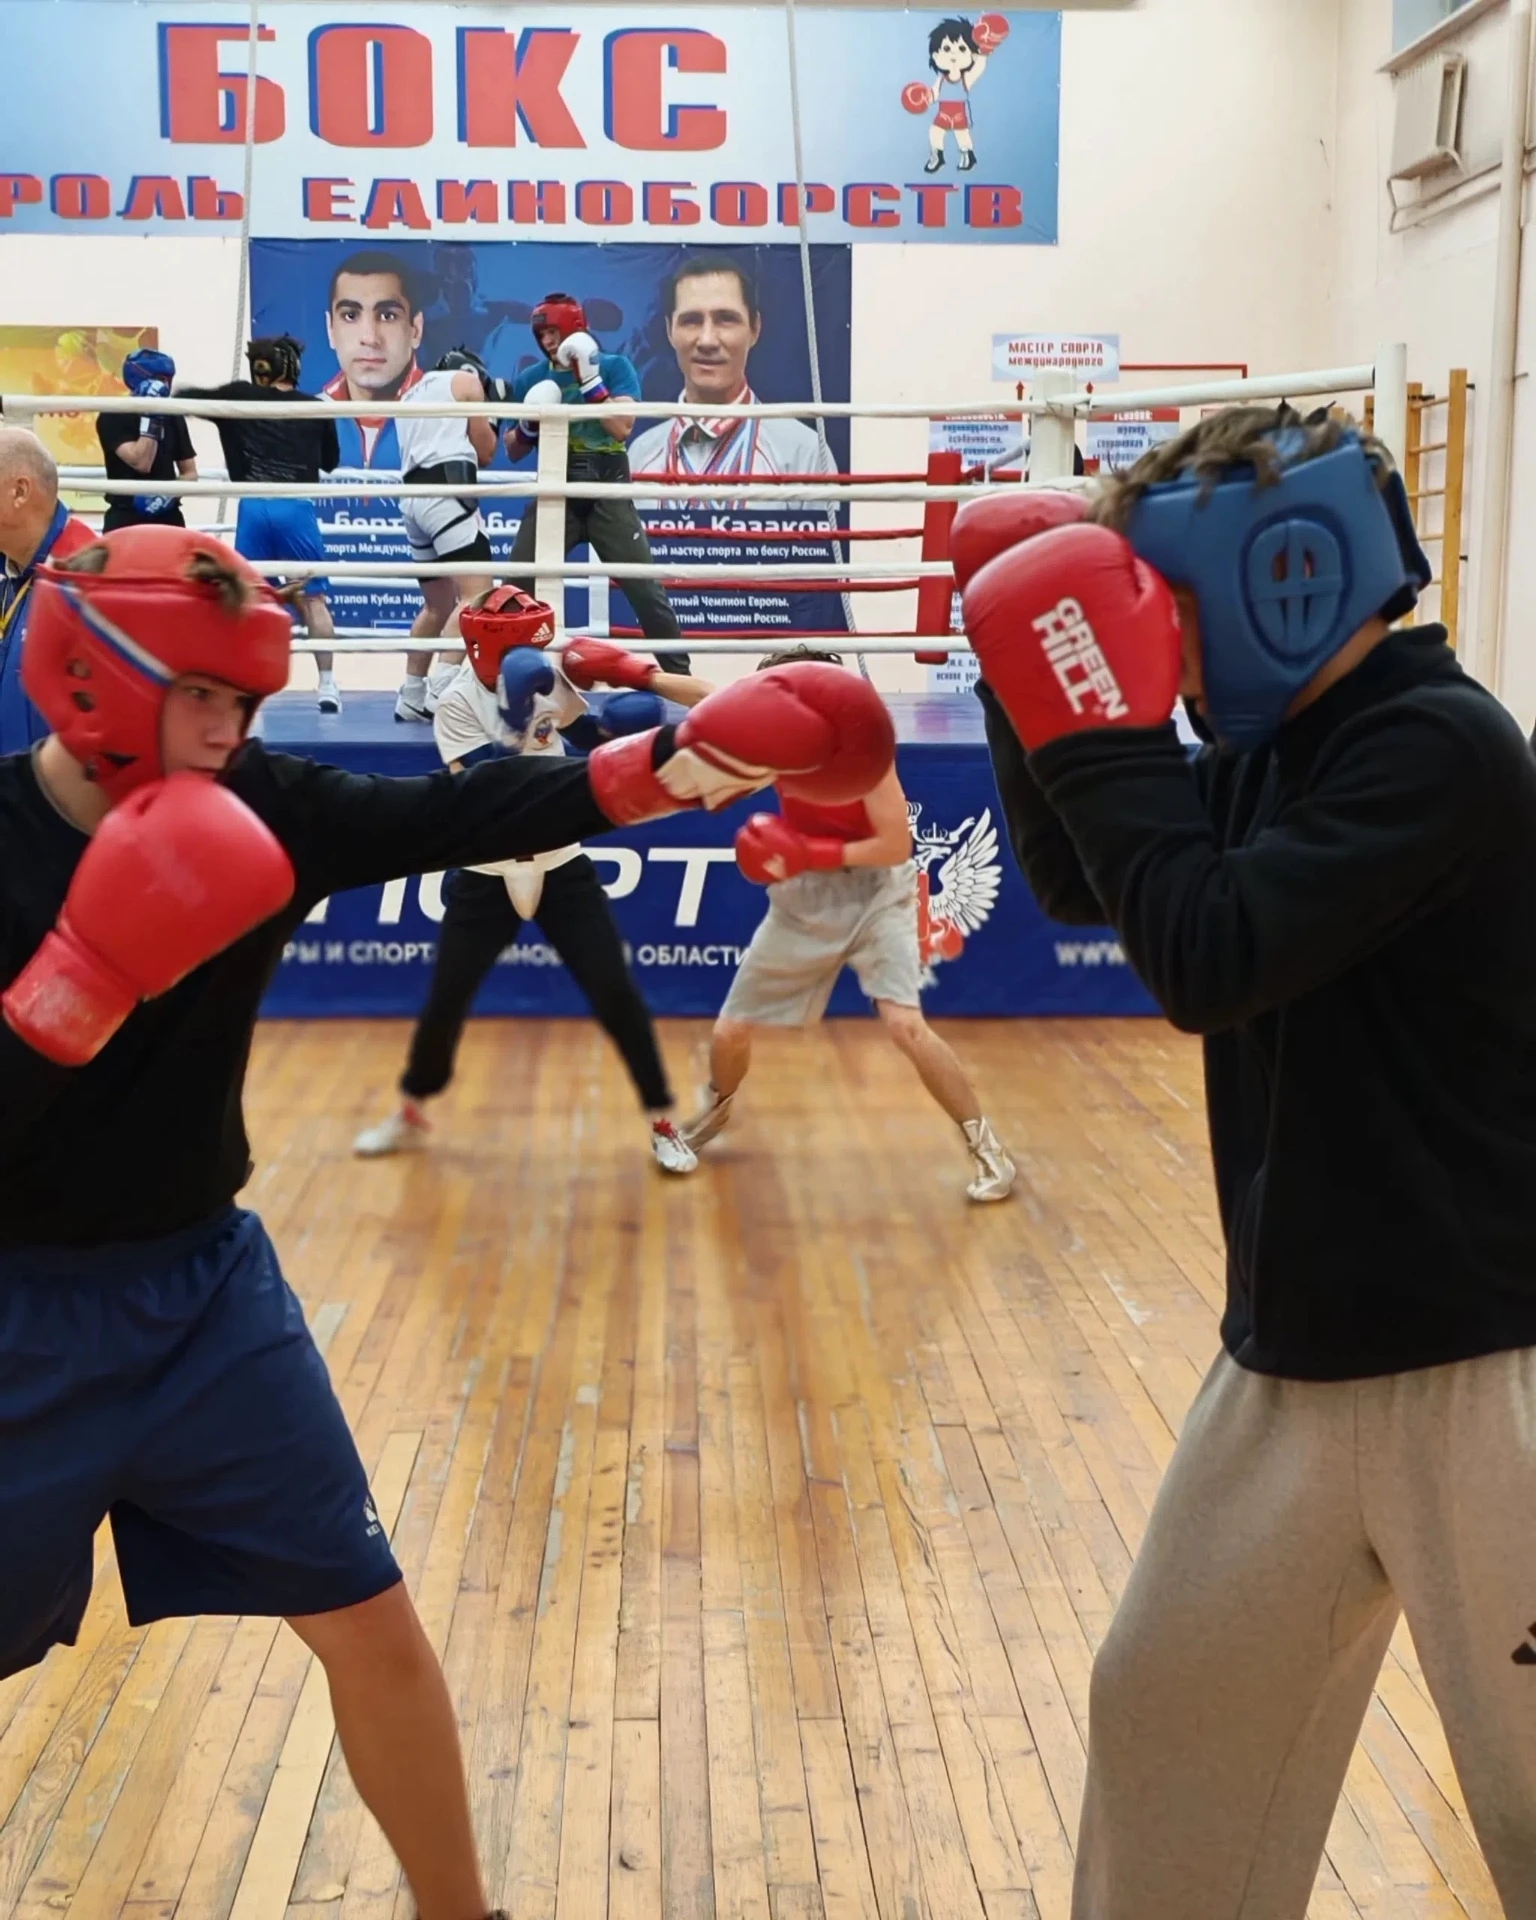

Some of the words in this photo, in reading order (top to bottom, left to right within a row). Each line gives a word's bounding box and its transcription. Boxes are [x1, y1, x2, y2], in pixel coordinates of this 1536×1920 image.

[156, 21, 727, 151] БОКС
[0, 173, 244, 220] РОЛЬ
[303, 177, 1022, 229] ЕДИНОБОРСТВ
[670, 546, 705, 558] мастер
[707, 546, 741, 558] спорта
[746, 546, 759, 557] по
[761, 545, 790, 559] боксу
[791, 545, 829, 557] России.
[370, 593, 401, 607] Кубка
[701, 596, 746, 607] Чемпион
[707, 612, 752, 624] Чемпион
[754, 612, 791, 624] России.
[1031, 608, 1094, 716] HILL
[1055, 596, 1130, 720] GREEN
